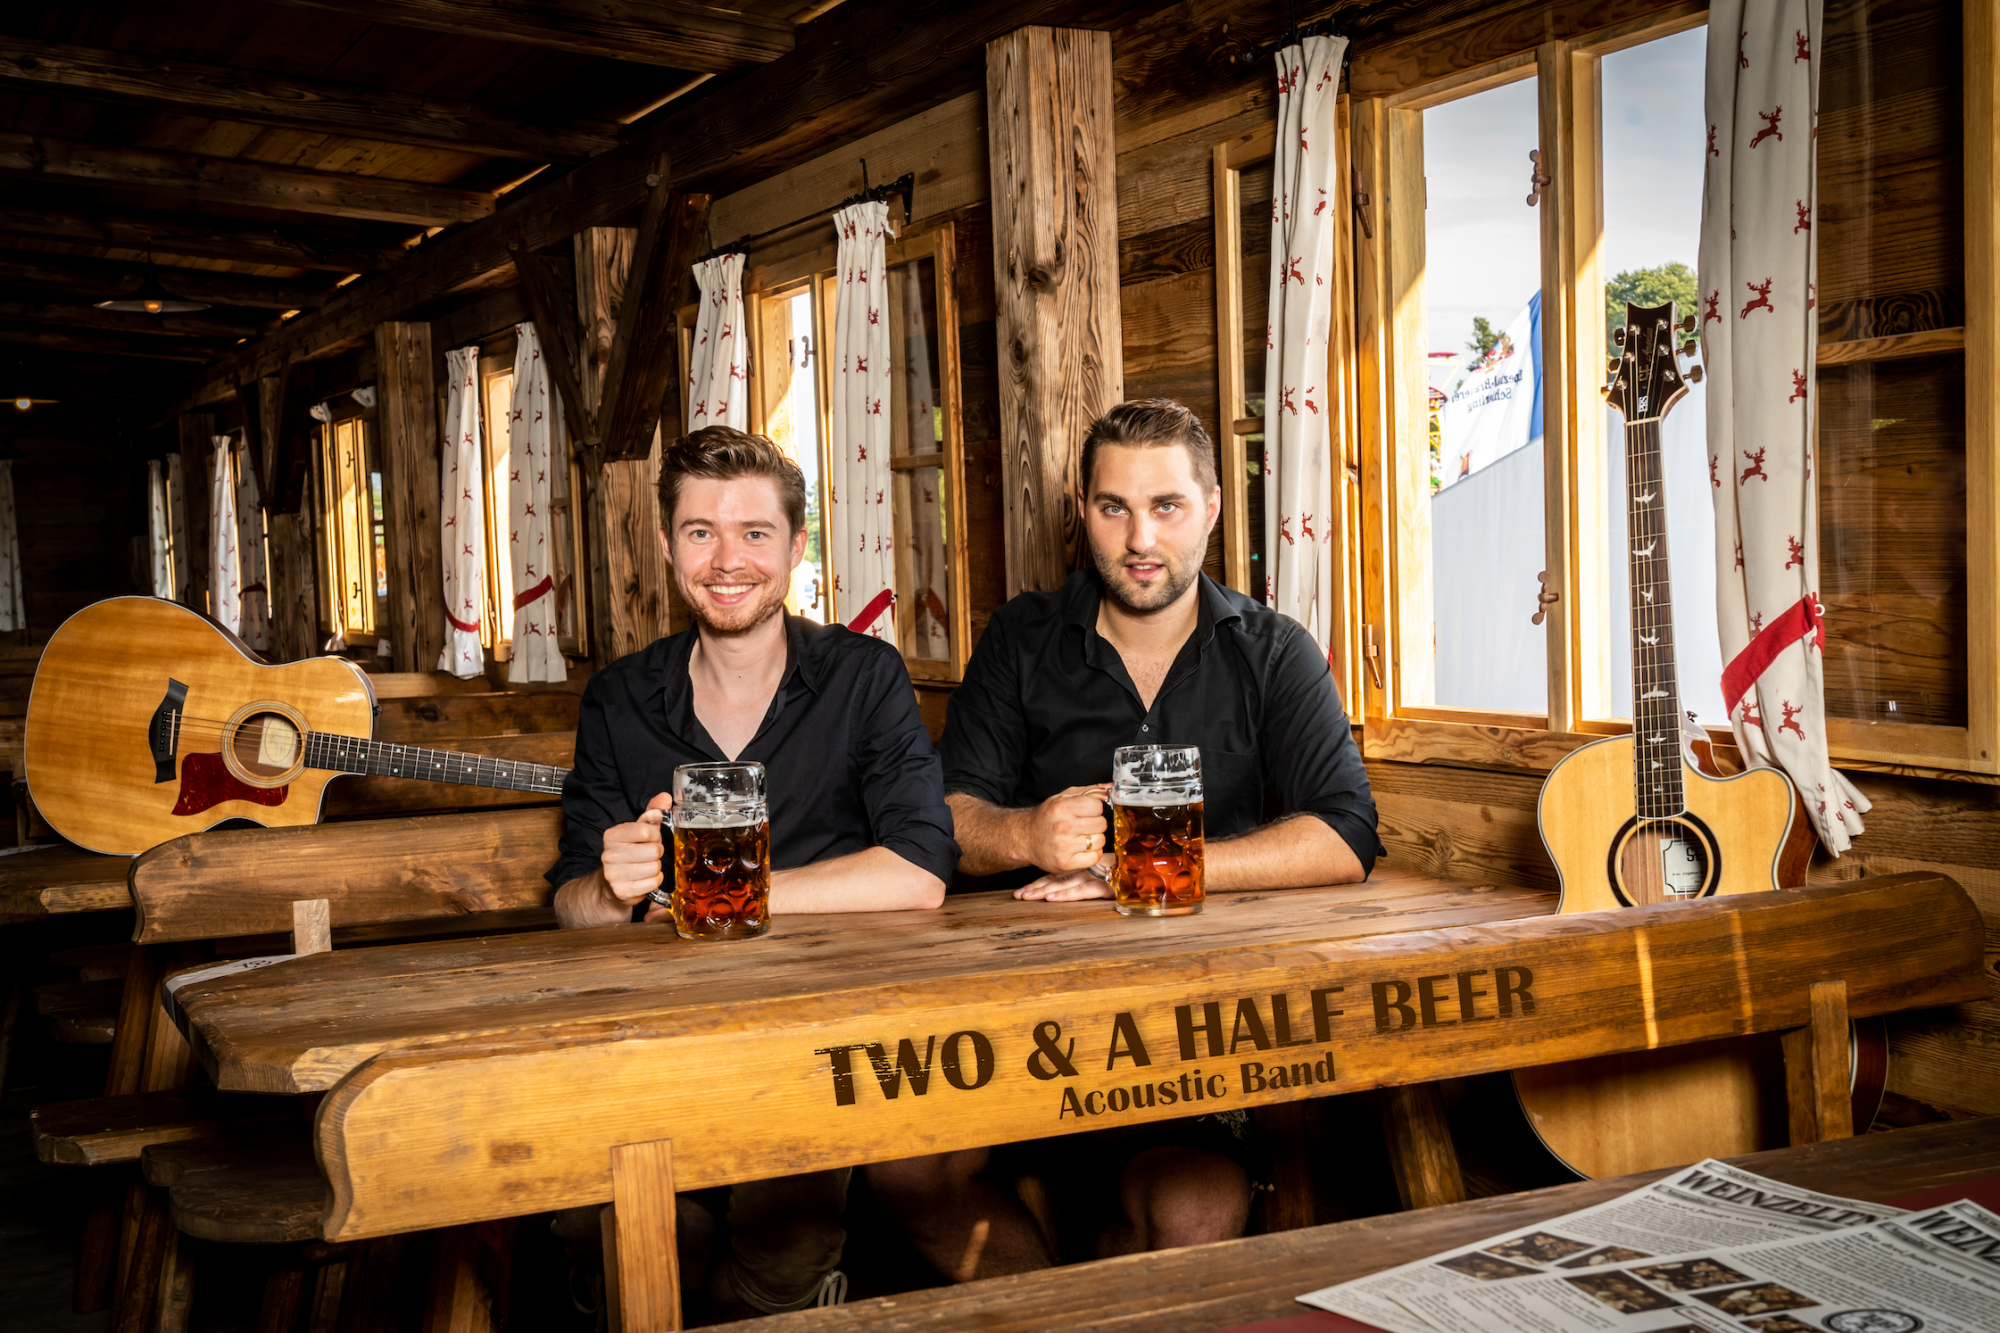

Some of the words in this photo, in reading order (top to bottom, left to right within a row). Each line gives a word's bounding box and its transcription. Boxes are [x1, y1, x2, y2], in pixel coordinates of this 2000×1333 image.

[815, 1031, 994, 1106] TWO
[1027, 1021, 1078, 1080] &
[1107, 1012, 1151, 1070] A
[1175, 986, 1344, 1060] HALF
[1372, 966, 1535, 1034] BEER
[1060, 1071, 1227, 1119] Acoustic
[1241, 1052, 1335, 1093] Band
